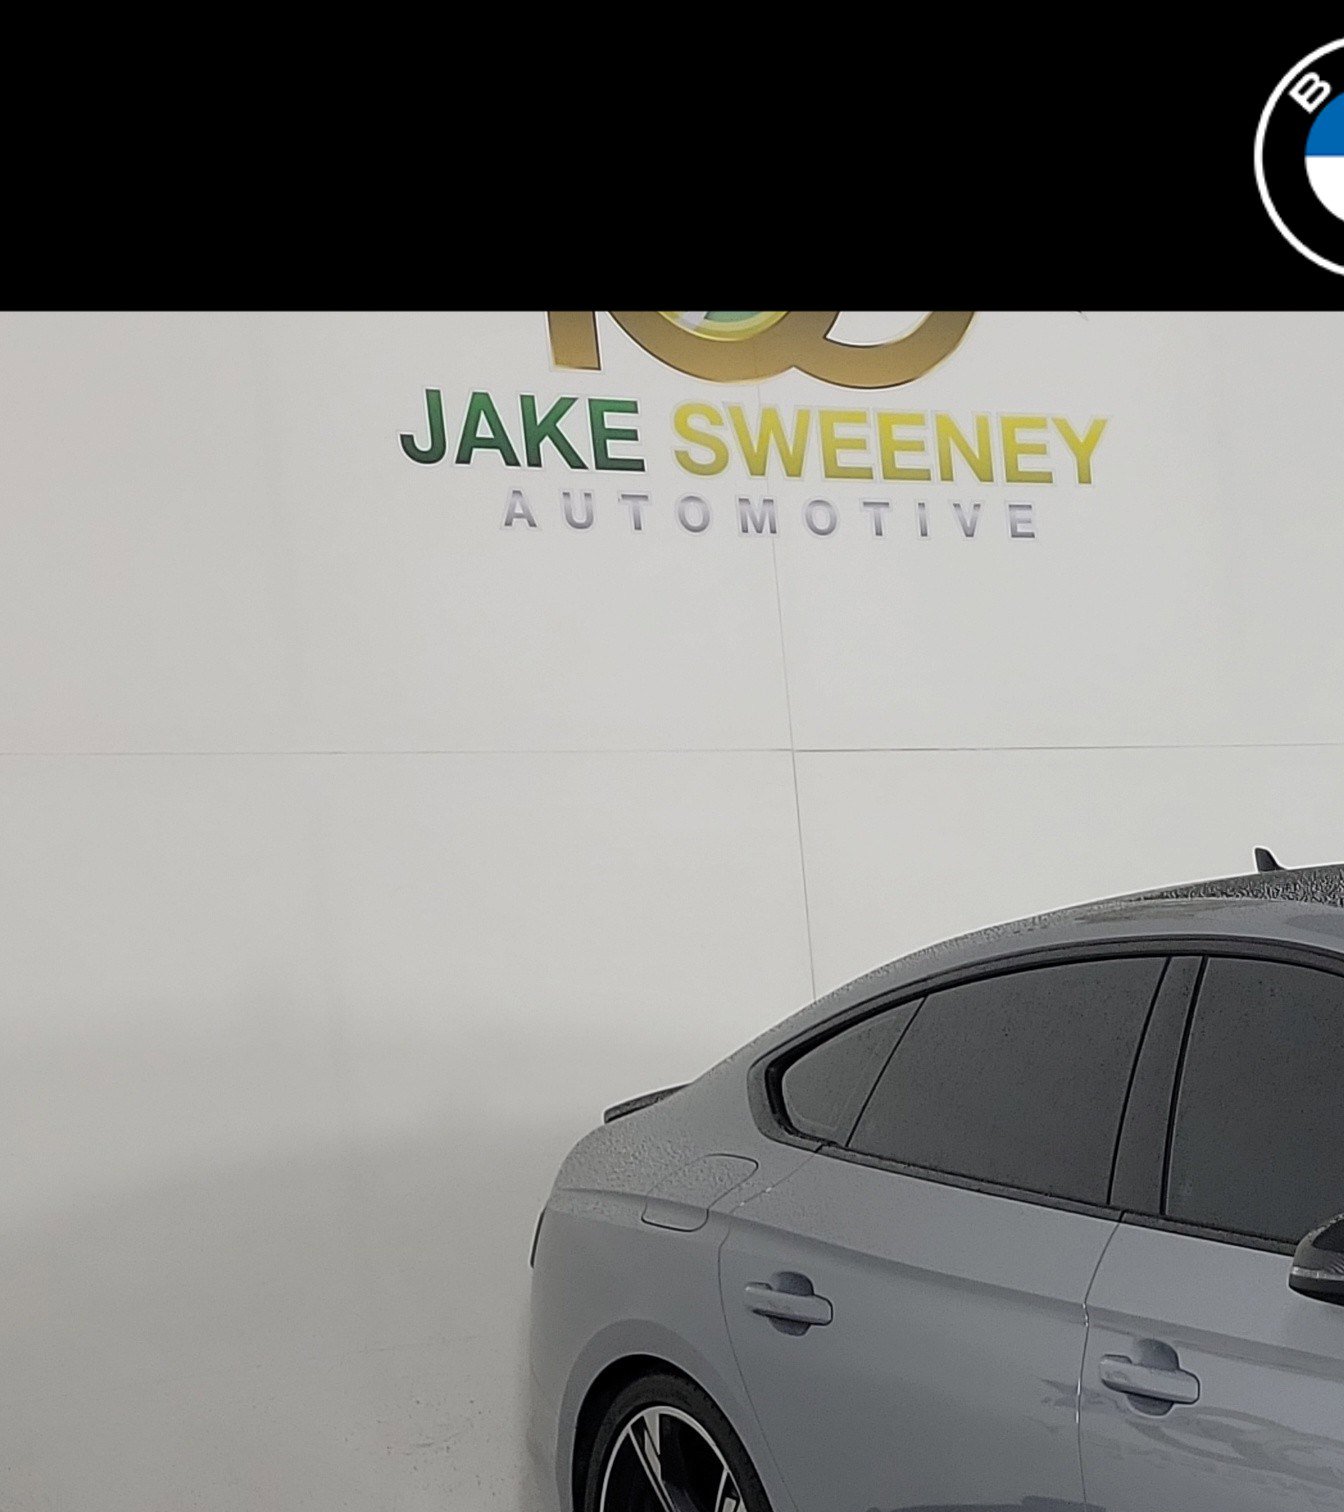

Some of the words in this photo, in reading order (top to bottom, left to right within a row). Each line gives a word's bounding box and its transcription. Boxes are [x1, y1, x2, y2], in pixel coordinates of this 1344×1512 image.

[400, 388, 646, 473] JAKE
[672, 400, 1108, 485] SWEENEY
[504, 490, 1037, 538] AUTOMOTIVE
